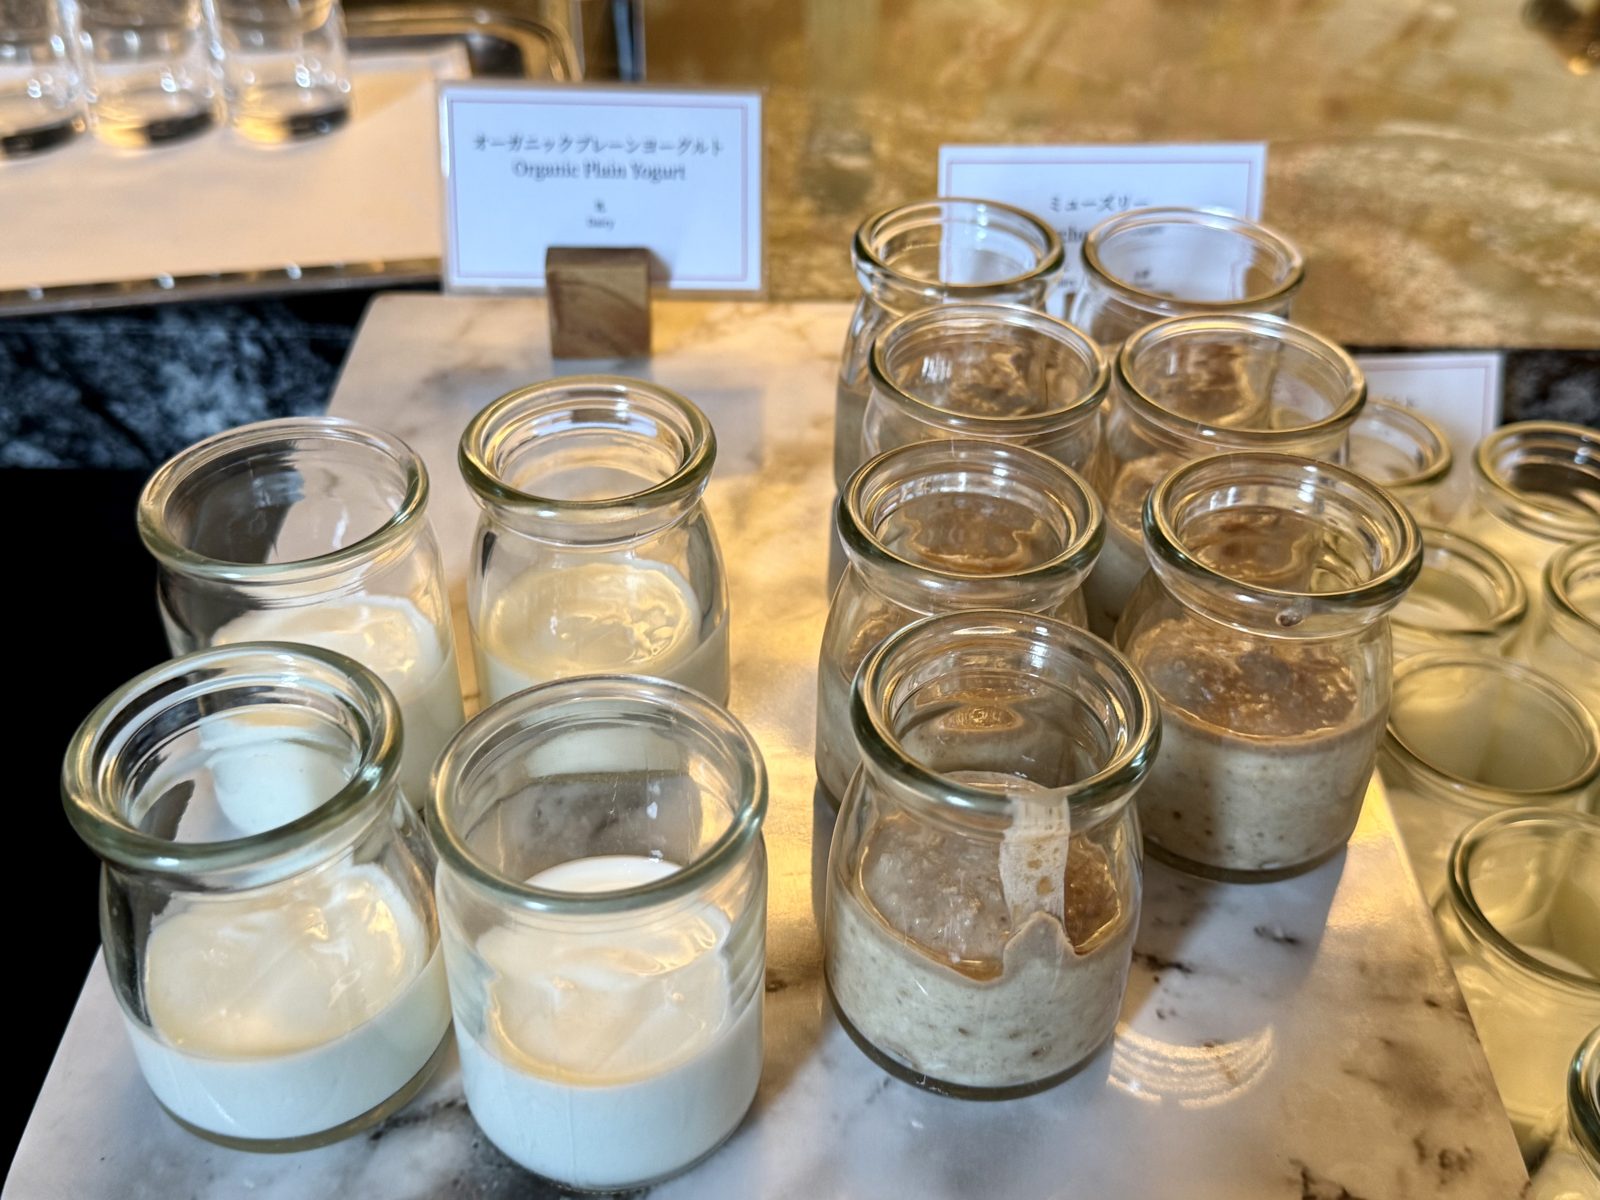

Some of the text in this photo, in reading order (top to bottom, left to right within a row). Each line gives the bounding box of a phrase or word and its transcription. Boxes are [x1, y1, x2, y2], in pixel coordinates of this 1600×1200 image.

[513, 160, 685, 183] Organic Plain Yogurt
[1051, 195, 1148, 211] ミューズリー
